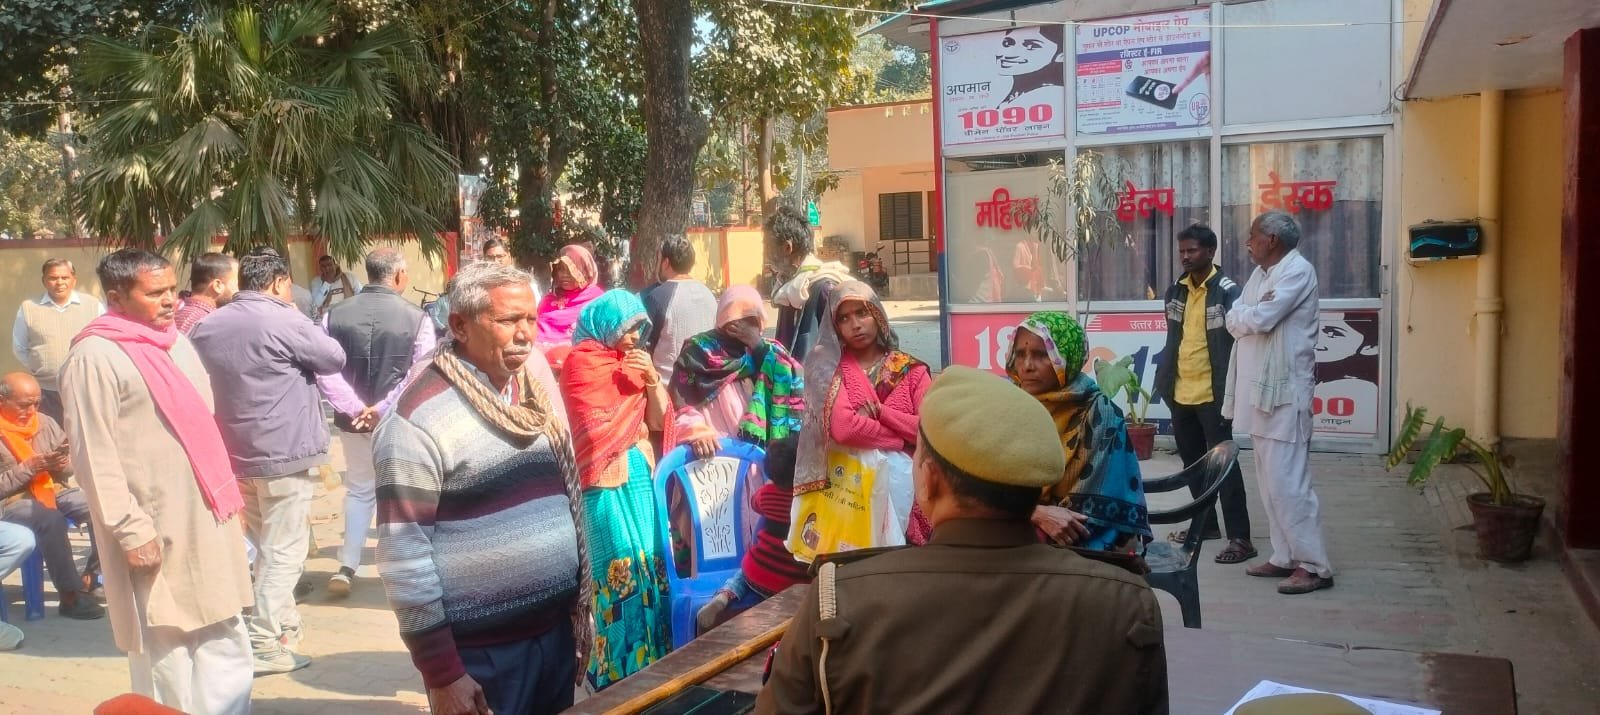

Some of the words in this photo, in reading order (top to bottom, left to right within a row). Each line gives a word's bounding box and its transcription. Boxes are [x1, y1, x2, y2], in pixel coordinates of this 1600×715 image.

[1093, 25, 1130, 37] UPCOP
[946, 80, 991, 95] अपमान
[958, 104, 1053, 129] 1090
[1116, 180, 1175, 221] हेल्प
[1259, 171, 1337, 214] डेस्क
[1129, 320, 1152, 330] उत्तर
[974, 326, 1017, 370] 18
